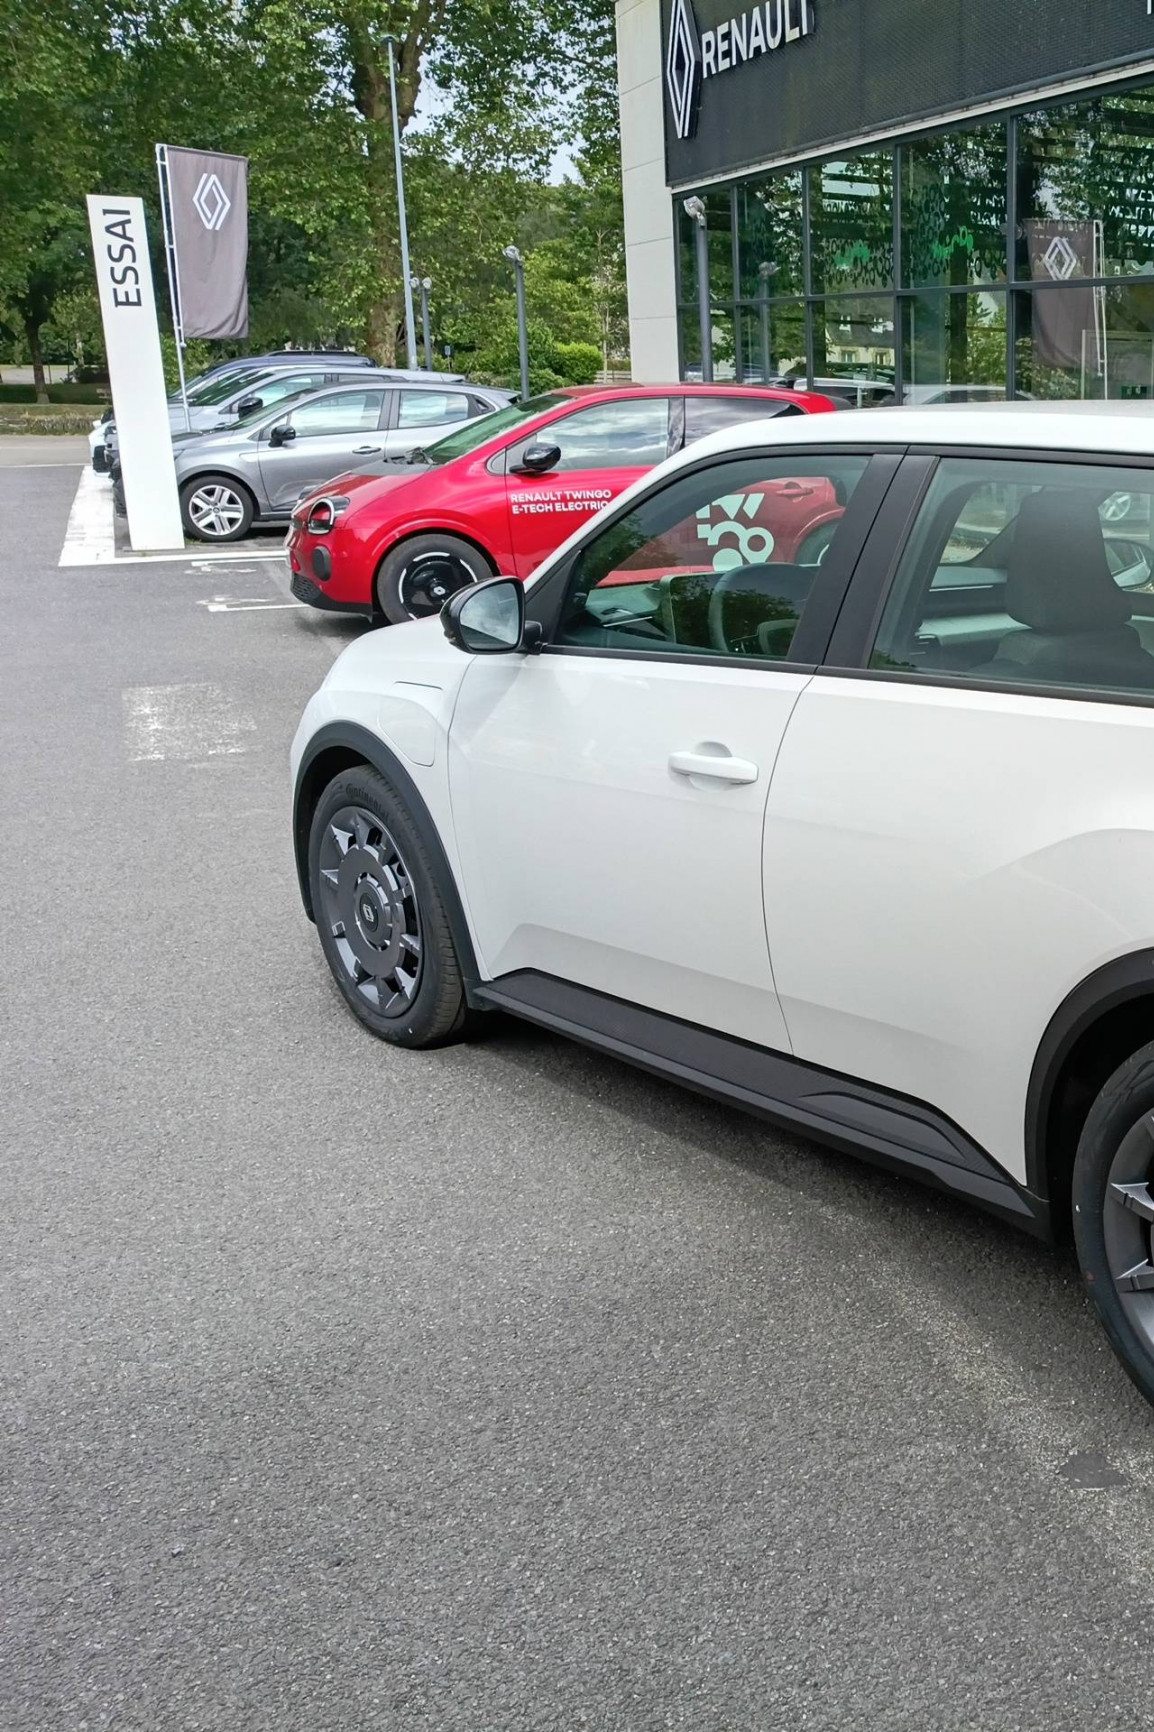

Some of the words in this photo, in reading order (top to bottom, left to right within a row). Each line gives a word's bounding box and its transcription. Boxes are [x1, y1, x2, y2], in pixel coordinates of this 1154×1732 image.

[701, 0, 808, 79] RENAULT
[102, 208, 142, 308] ESSAI
[510, 491, 562, 503] RENAULT
[564, 489, 612, 500] TWINGO
[512, 503, 553, 515] E-TECH
